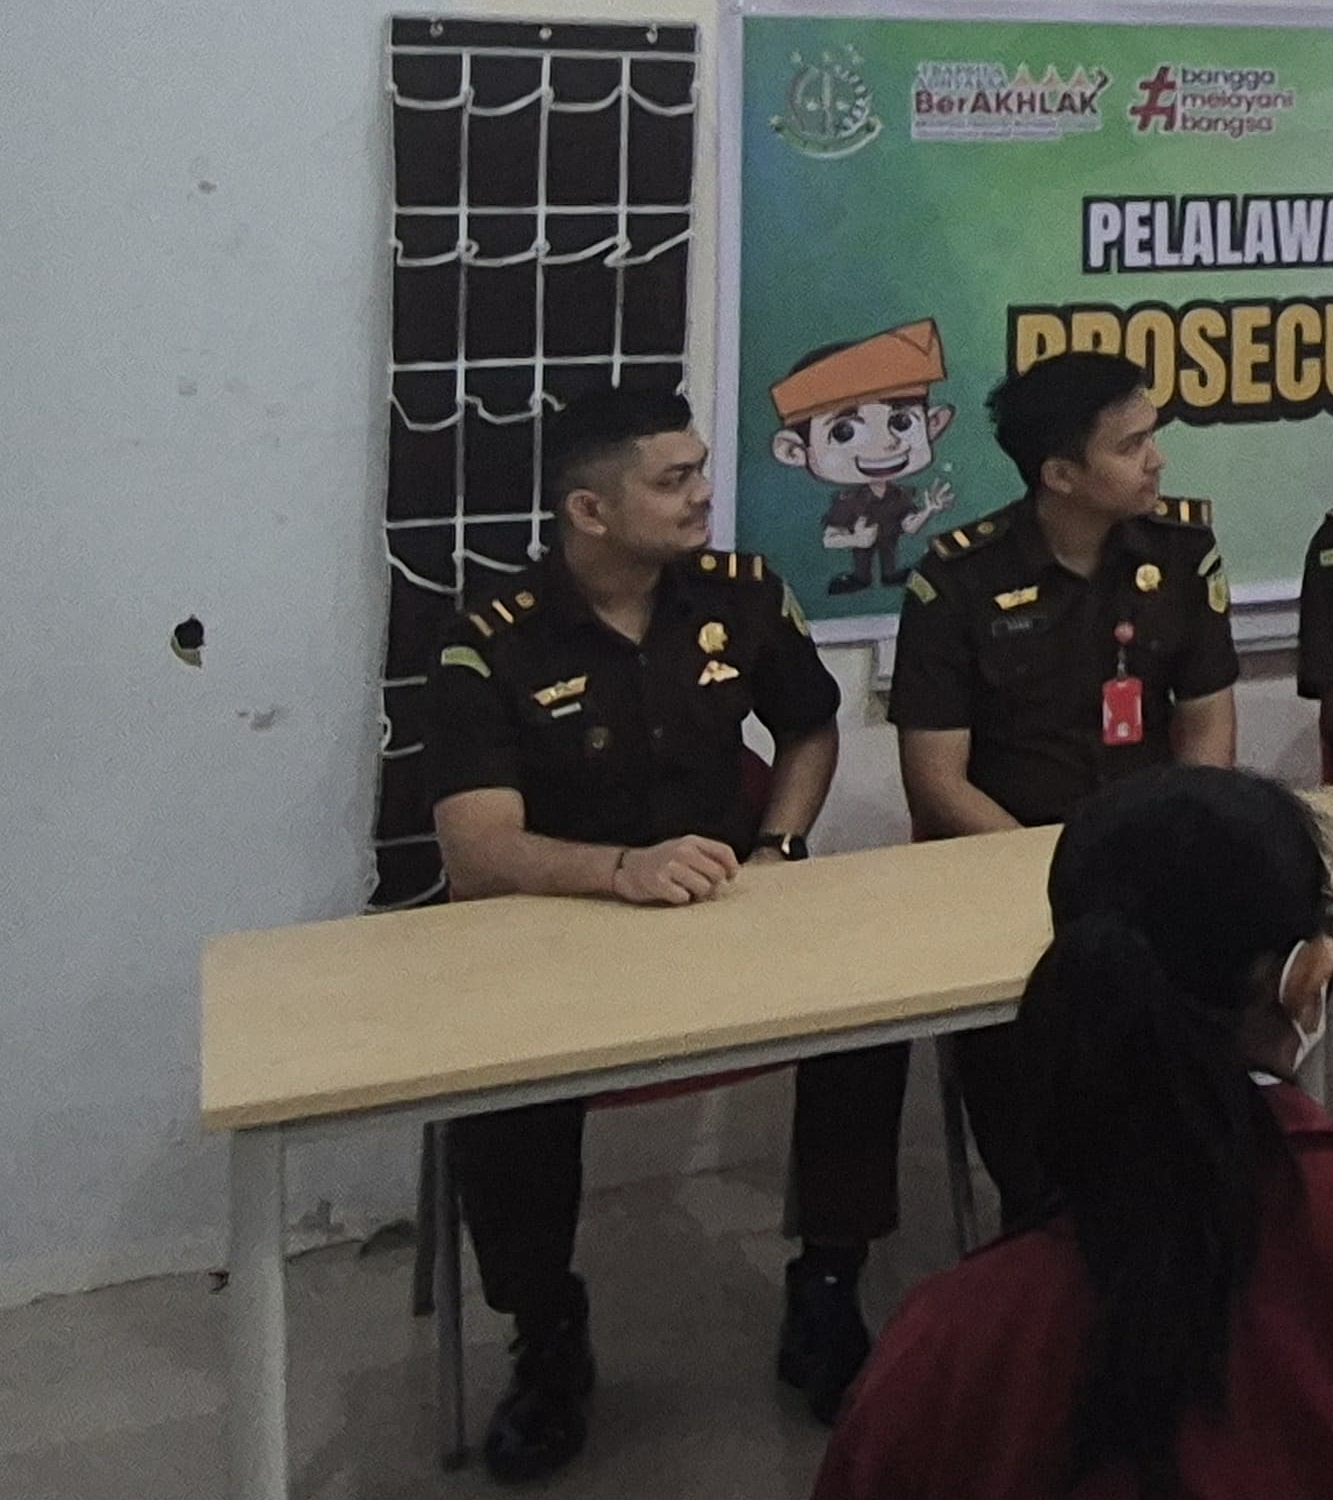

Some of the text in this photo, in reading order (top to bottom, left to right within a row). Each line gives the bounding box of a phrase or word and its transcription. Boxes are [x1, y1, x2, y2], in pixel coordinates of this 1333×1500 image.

[1181, 68, 1276, 91] bangga
[914, 83, 1102, 114] BerAKHLAK
[1181, 90, 1295, 113] melayani
[1181, 112, 1274, 139] bangsa
